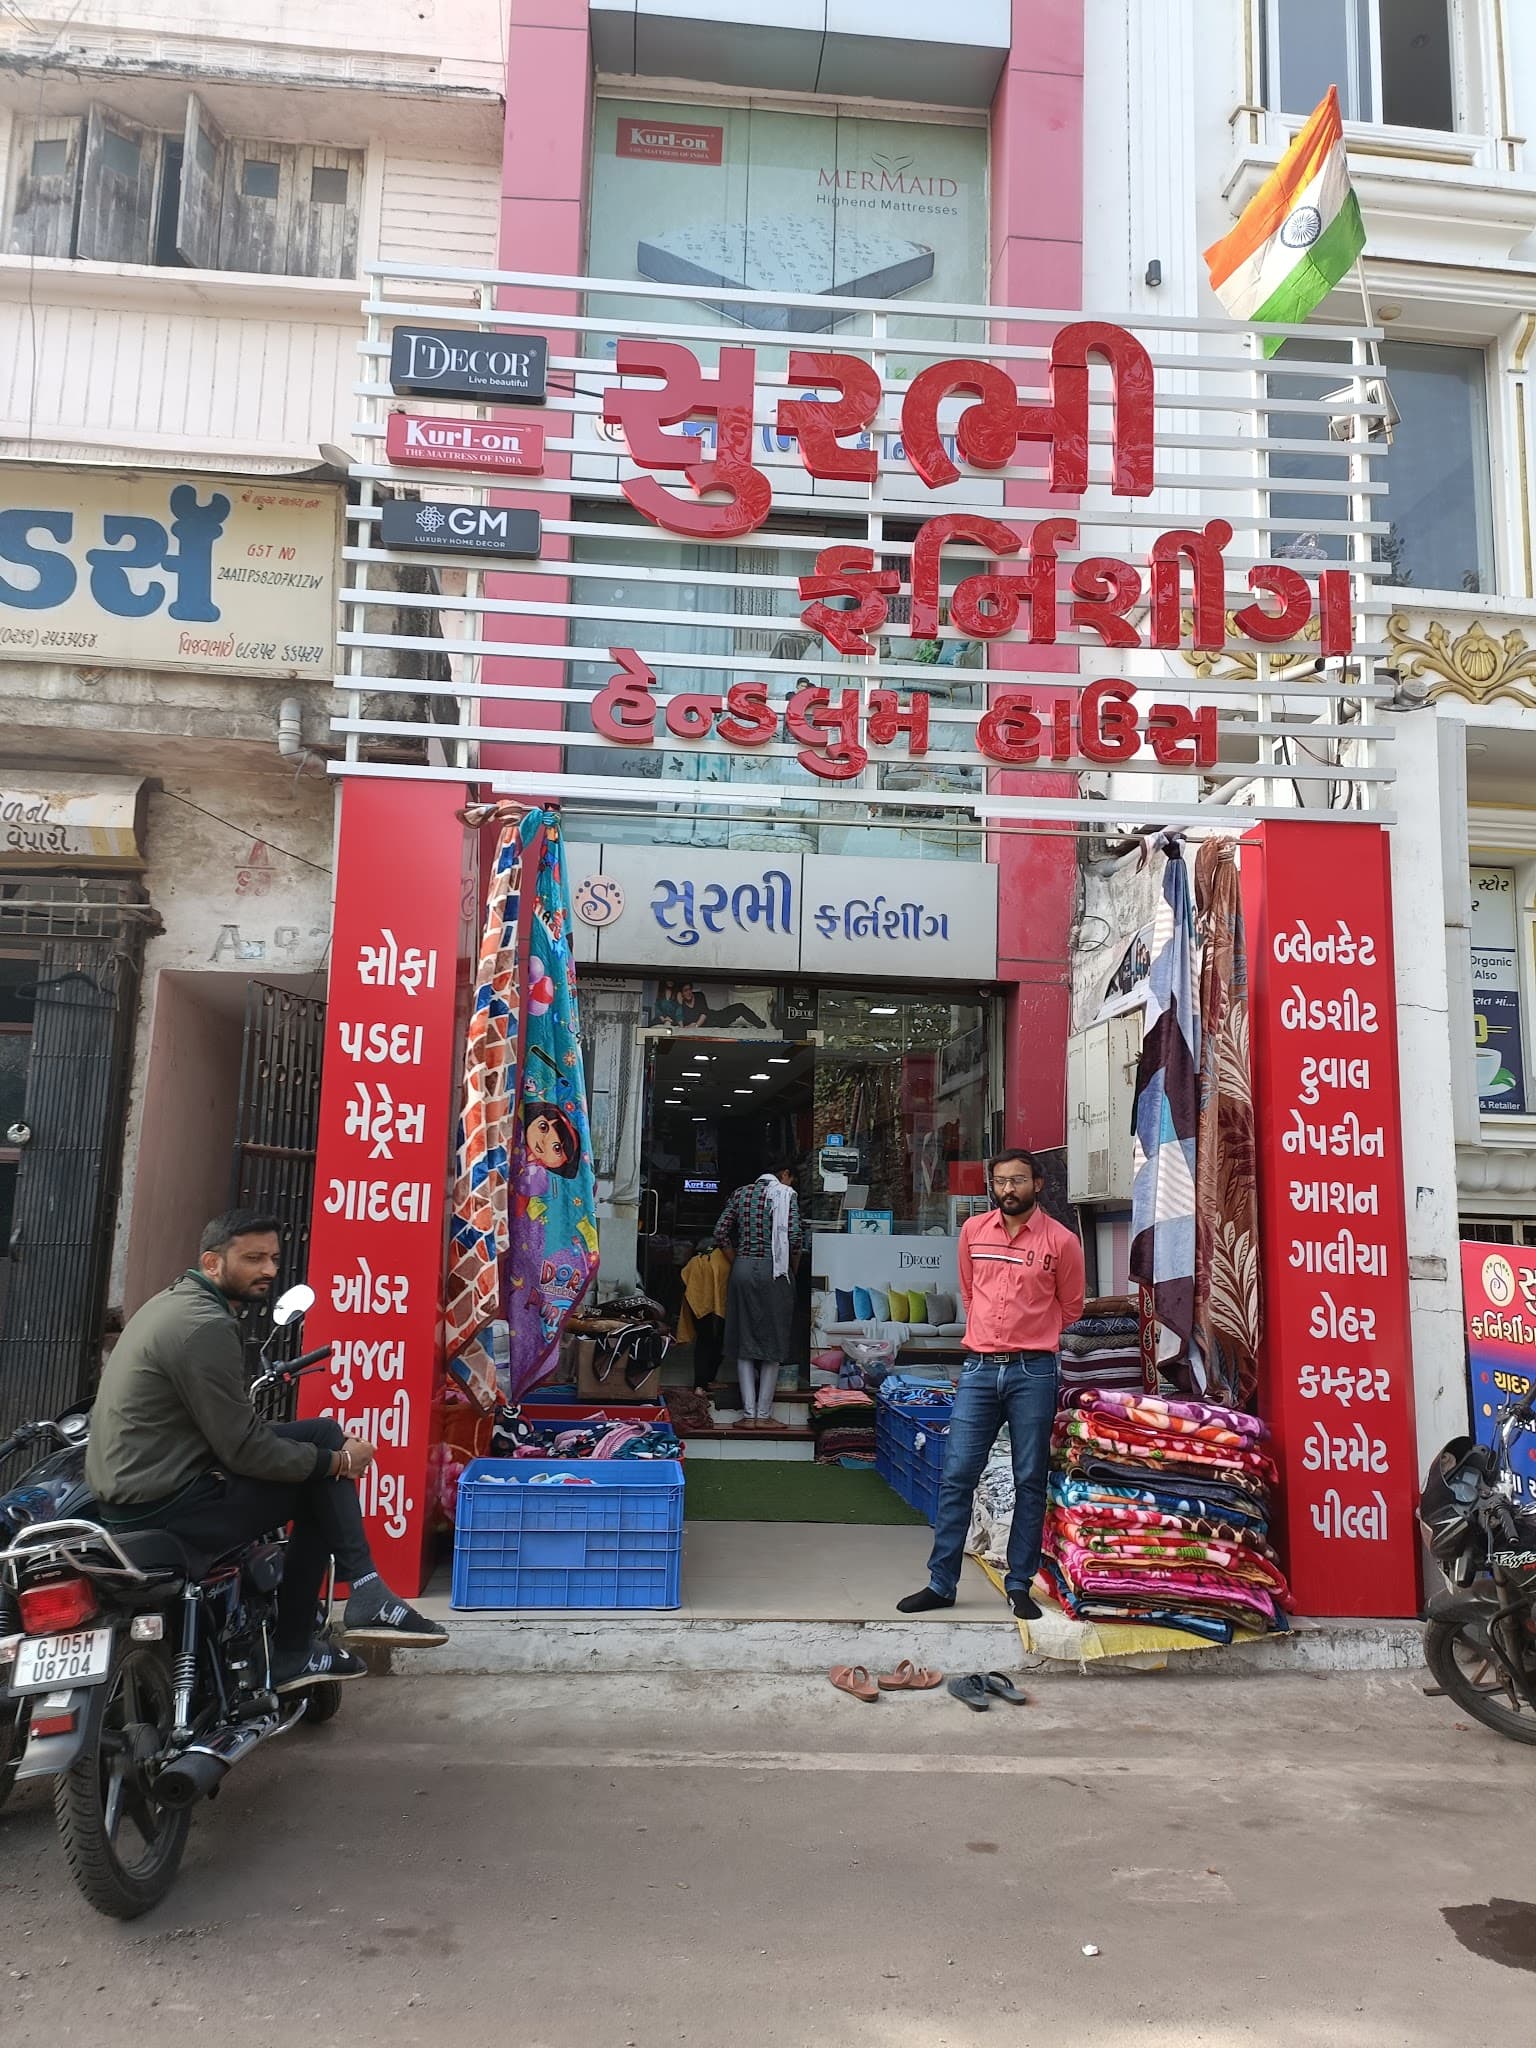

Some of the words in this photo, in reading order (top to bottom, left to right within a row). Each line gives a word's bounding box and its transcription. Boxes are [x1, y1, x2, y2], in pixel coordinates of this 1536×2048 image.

[630, 128, 709, 150] Kurl-on
[816, 193, 877, 210] Highend
[881, 199, 958, 216] Mattresses
[817, 167, 958, 198] MERMAID
[400, 334, 531, 380] D'DECOR
[469, 375, 488, 385] Live
[489, 377, 528, 388] beautiful
[404, 420, 522, 452] Kurl-on
[602, 319, 1156, 540] સુરભી
[405, 448, 426, 457] THE
[427, 450, 479, 462] MATTRESS
[480, 454, 494, 463] OF
[495, 455, 523, 465] INDIA
[415, 535, 448, 545] LUXURY
[450, 538, 474, 547] HOME
[475, 540, 506, 548] DECOR
[449, 507, 508, 538] GM
[247, 544, 273, 558] GST
[278, 547, 296, 561] NO
[590, 647, 930, 781] હેન્ડલુમ
[974, 677, 1219, 768] હાઉસ
[1478, 874, 1510, 892] સ્ટોર
[650, 869, 797, 947] સુરભી
[357, 928, 438, 996] સોફા
[1273, 919, 1377, 966] બ્લેનકેટ
[1474, 970, 1498, 980] Also
[1280, 985, 1379, 1033] બેડશીટ
[338, 1021, 424, 1065] પડદા
[1298, 1056, 1370, 1105] ટુવાલ
[344, 1081, 426, 1159] મેટ્રેસ
[1480, 1101, 1486, 1109] &
[1488, 1101, 1521, 1110] Retailer
[1281, 1108, 1385, 1158] નેપકીન
[323, 1178, 432, 1223] ગાદલા
[1289, 1180, 1379, 1215] આશન
[1288, 1228, 1388, 1277] ગાલીચા
[330, 1257, 409, 1315] ઓડર
[1309, 1291, 1377, 1341] ડોહર
[330, 1340, 405, 1400] મુજબ
[1493, 1370, 1531, 1395] ચાદર
[1302, 1421, 1389, 1474] ડોરમેટ
[1310, 1489, 1388, 1541] પીલ્લો
[33, 1654, 91, 1683] U8704
